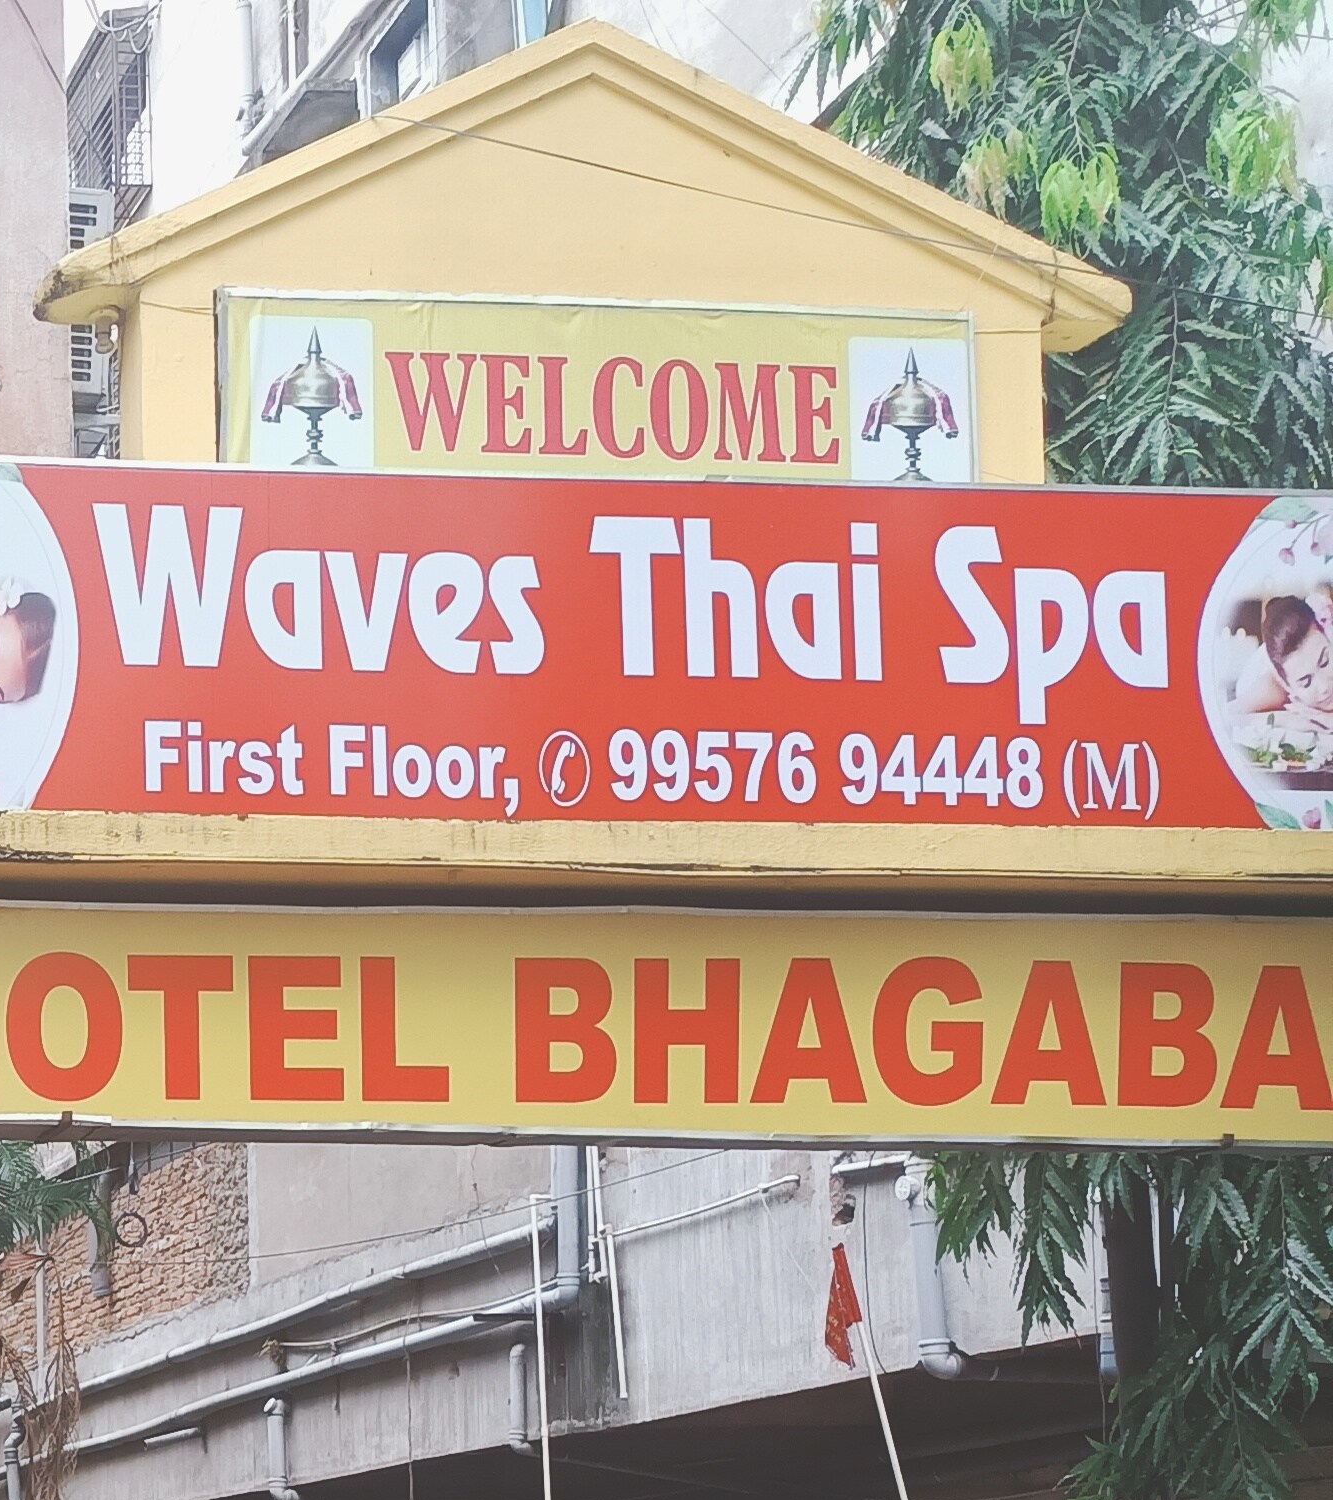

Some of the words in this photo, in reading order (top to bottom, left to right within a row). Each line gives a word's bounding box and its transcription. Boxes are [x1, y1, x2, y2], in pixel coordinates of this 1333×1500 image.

[384, 350, 841, 466] WELCOME
[91, 501, 546, 676] Waves
[588, 515, 884, 683] Thai
[933, 524, 1169, 726] Spa
[142, 718, 305, 797] First
[328, 723, 521, 819] Floor,
[607, 728, 817, 804] 99576
[838, 733, 1045, 808] 94448
[1061, 739, 1162, 822] (M)
[514, 955, 1333, 1111] BHAGABA
